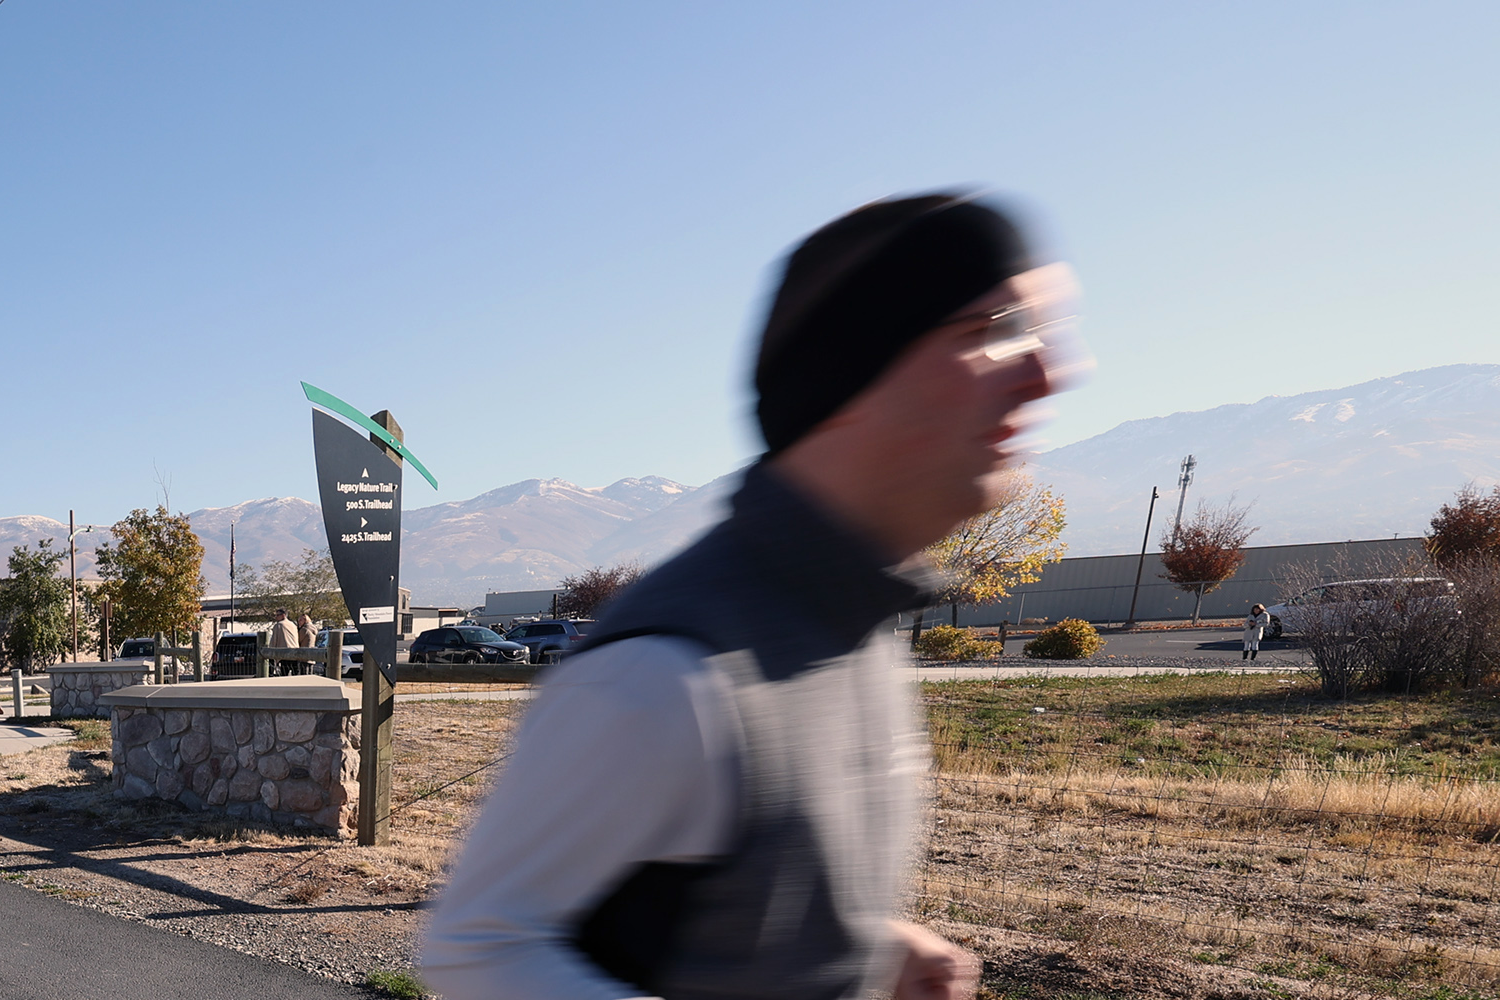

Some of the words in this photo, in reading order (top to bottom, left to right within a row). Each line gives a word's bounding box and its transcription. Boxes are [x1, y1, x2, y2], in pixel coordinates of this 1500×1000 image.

[337, 481, 359, 494] Legacy
[359, 482, 379, 492] Nature
[379, 483, 393, 492] Trail
[346, 501, 358, 511] 500
[358, 499, 365, 509] S.
[365, 499, 393, 509] Trailhead
[341, 533, 357, 544] 2425
[357, 531, 364, 541] S.
[364, 531, 392, 541] Trailhead
